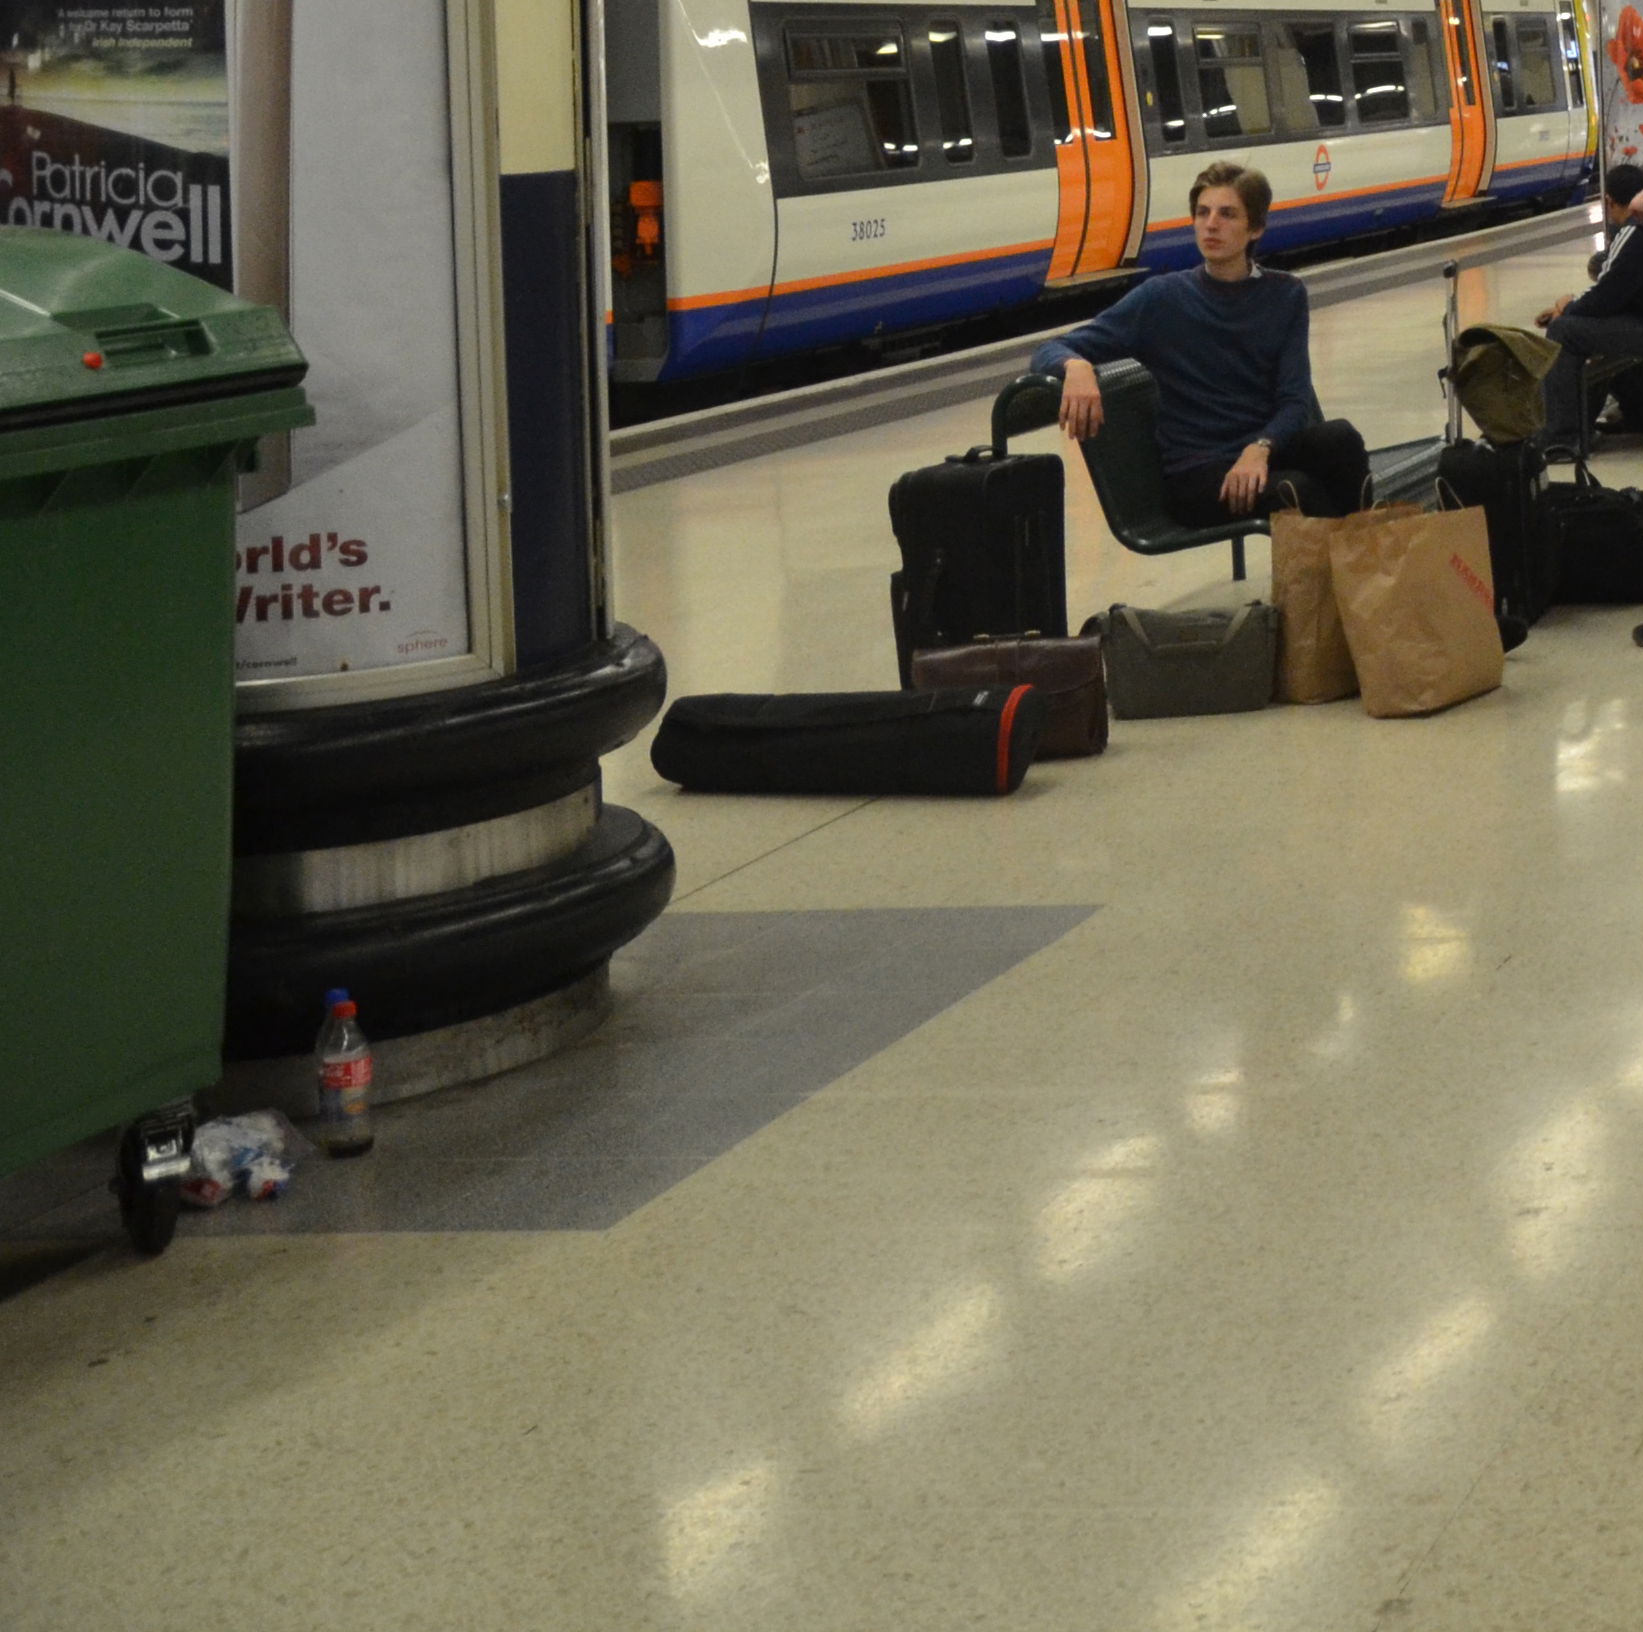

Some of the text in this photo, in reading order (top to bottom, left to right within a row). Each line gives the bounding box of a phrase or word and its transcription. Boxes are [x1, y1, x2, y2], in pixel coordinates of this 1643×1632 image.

[99, 20, 122, 34] Kay
[31, 151, 184, 208] Patricia
[0, 168, 222, 264] ornwell
[851, 218, 886, 242] 38025
[236, 532, 368, 575] rld's
[396, 637, 448, 655] sphere
